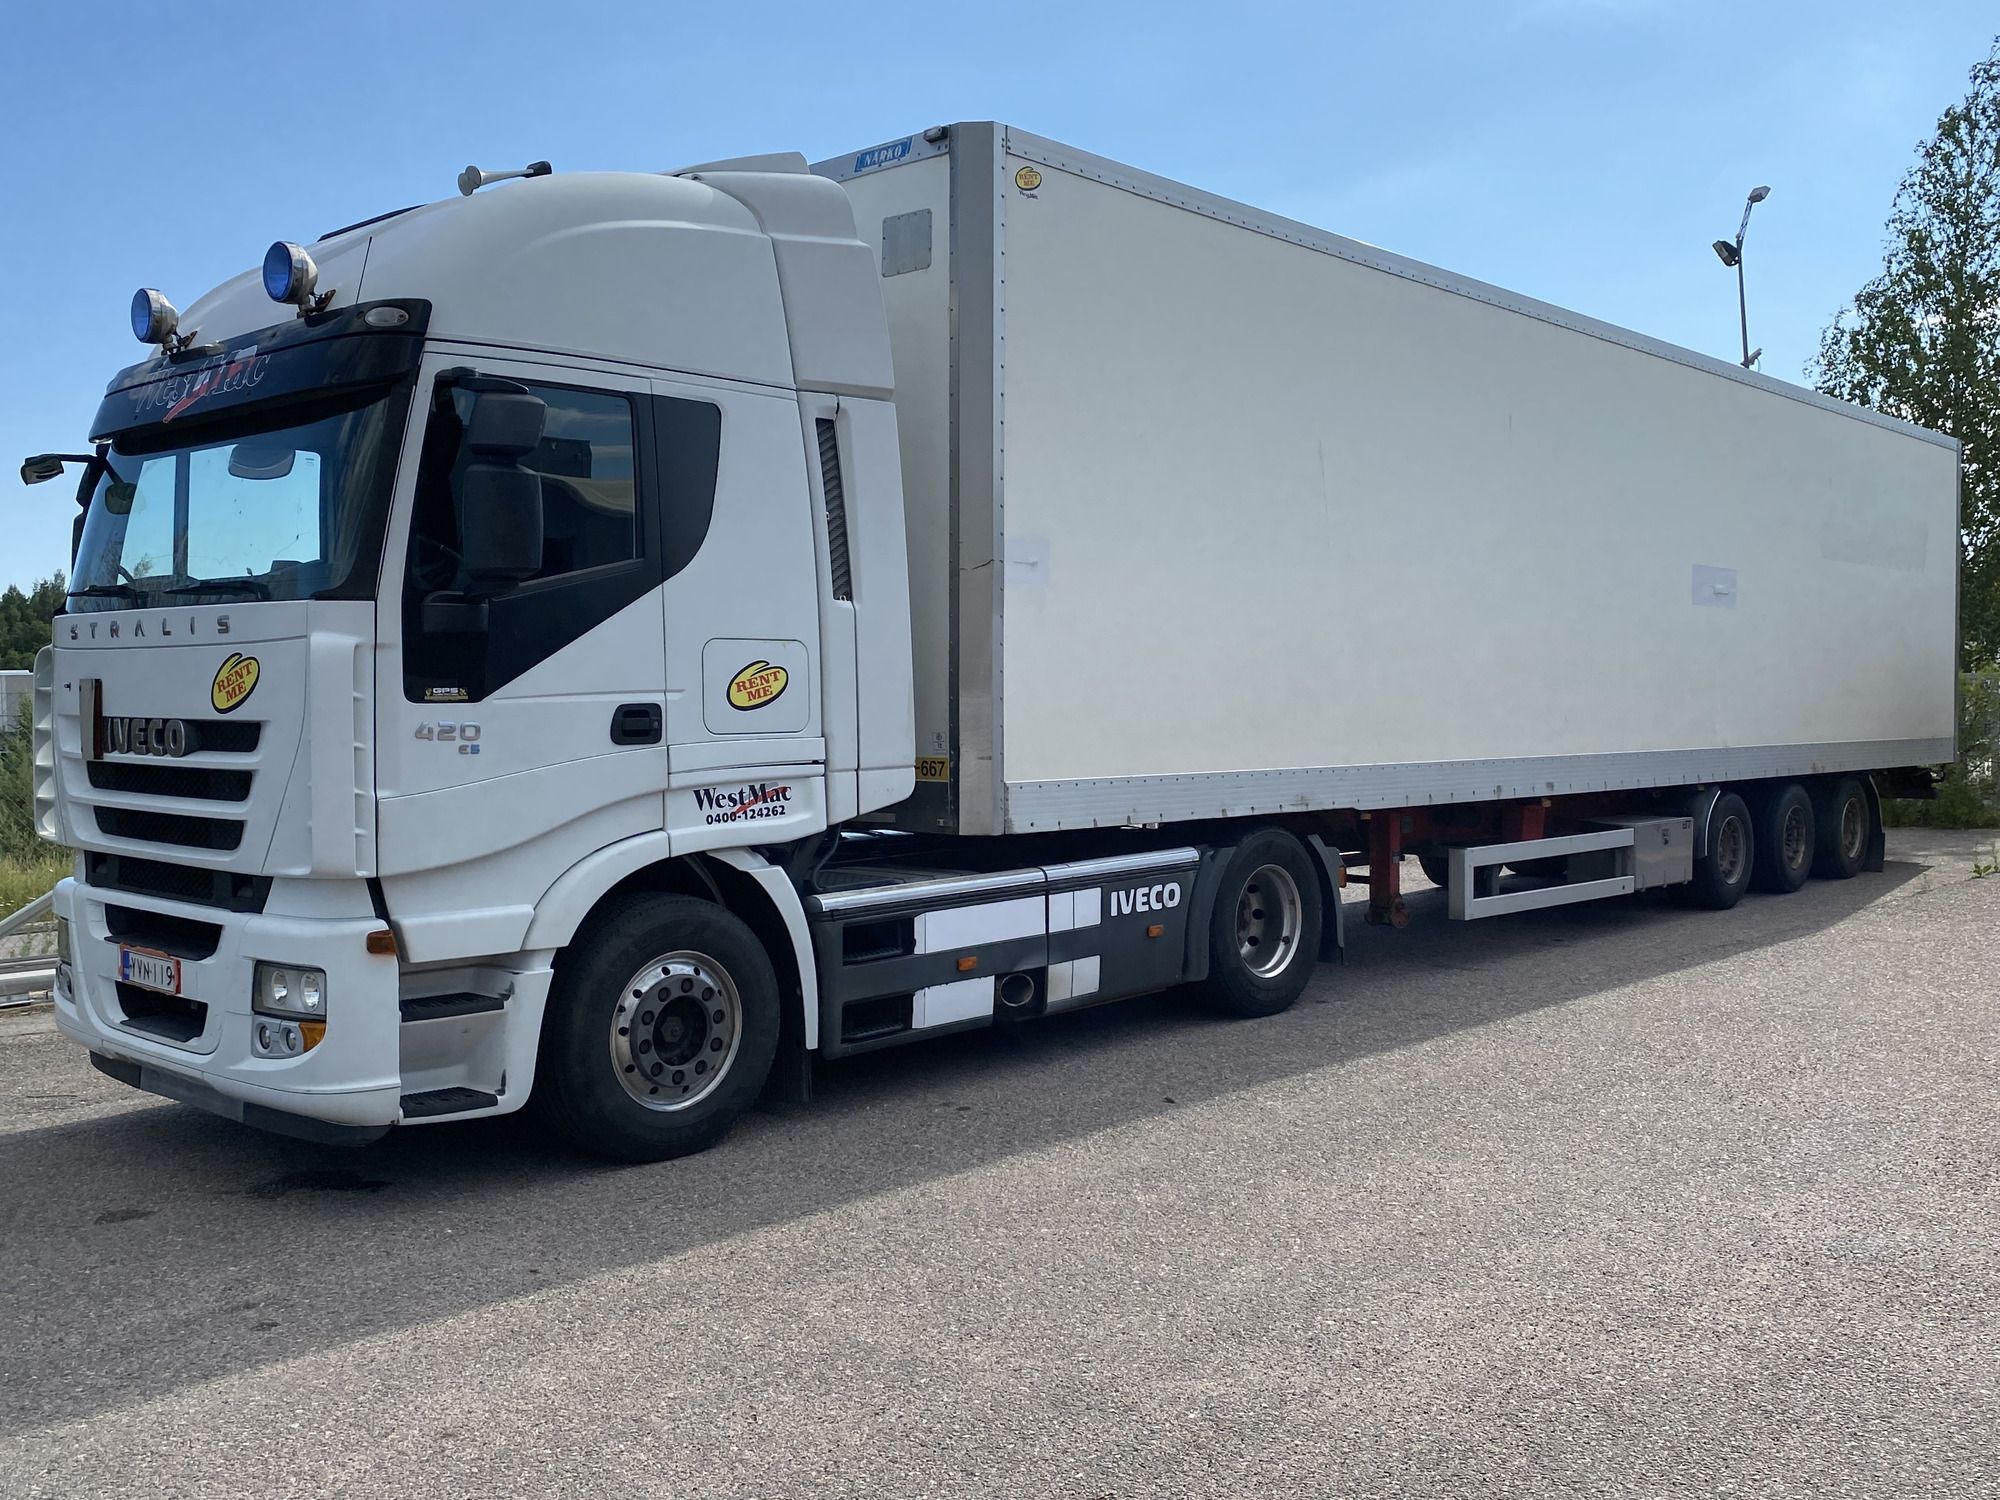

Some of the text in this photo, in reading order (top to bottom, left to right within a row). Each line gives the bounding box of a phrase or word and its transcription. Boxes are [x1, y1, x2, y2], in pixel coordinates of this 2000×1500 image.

[70, 614, 230, 641] STRALIS
[216, 661, 252, 693] RENT
[735, 670, 781, 694] RENT
[225, 680, 247, 703] ME
[746, 685, 773, 702] ME
[103, 717, 186, 758] IVECO
[414, 721, 481, 742] 420
[693, 783, 792, 811] WestMac
[706, 804, 786, 826] 0400-124262
[1111, 882, 1181, 917] IVECO
